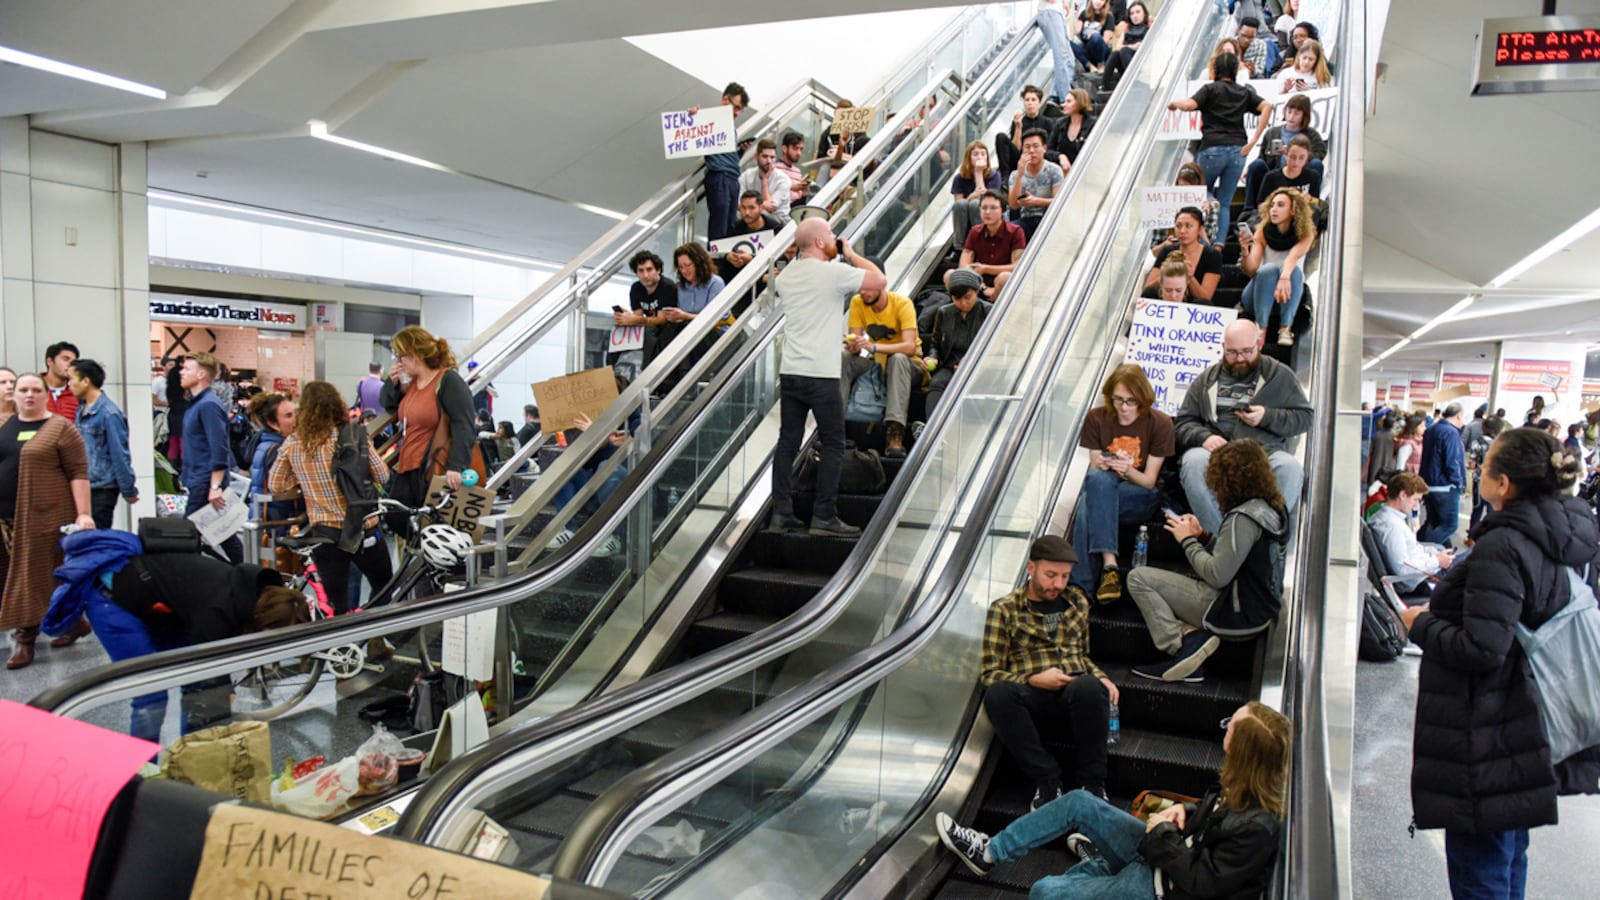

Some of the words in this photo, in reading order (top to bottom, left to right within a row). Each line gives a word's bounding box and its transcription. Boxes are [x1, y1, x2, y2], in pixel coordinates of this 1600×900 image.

[1496, 48, 1569, 62] Please
[840, 108, 870, 121] STOP
[667, 140, 688, 155] THE
[1146, 192, 1204, 203] MATTHEW
[1145, 303, 1178, 319] GET
[1187, 307, 1224, 327] YOUR
[1168, 328, 1222, 344] ORANGE
[1149, 342, 1186, 356] WHITE
[1134, 351, 1211, 369] SUPREMACIST
[1142, 366, 1166, 381] NDS
[222, 822, 383, 888] FAMILIES
[407, 871, 460, 900] OF
